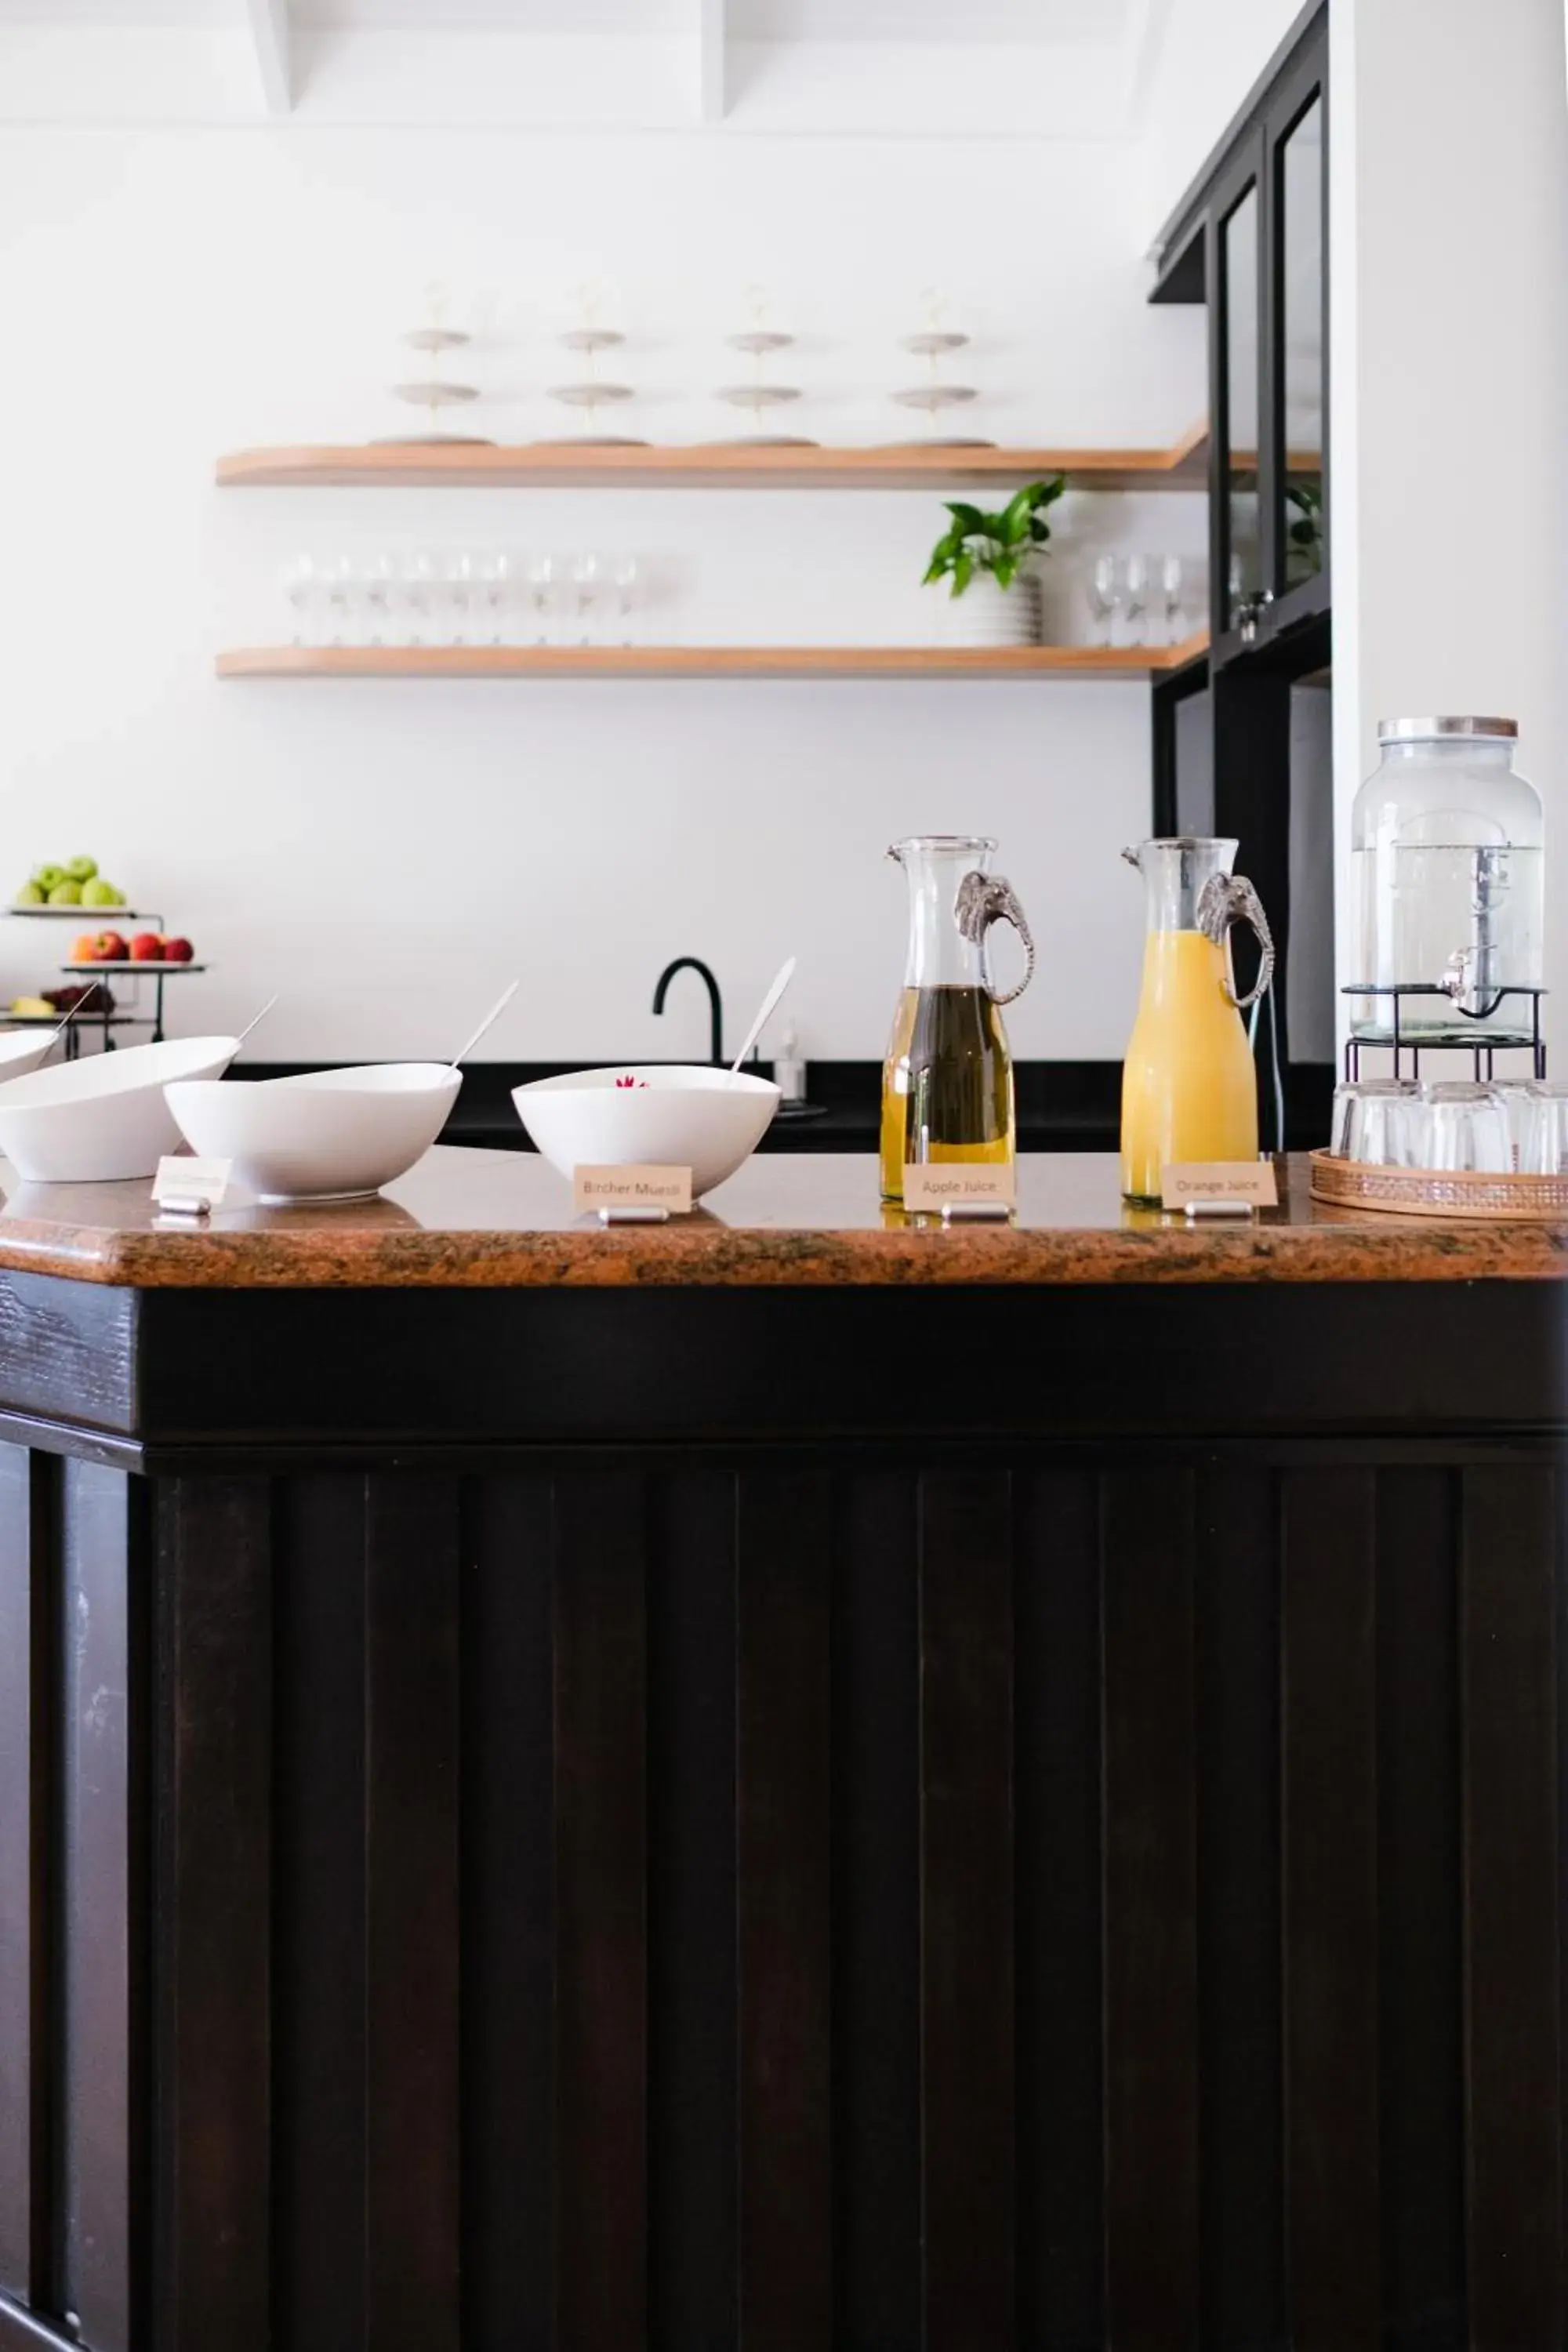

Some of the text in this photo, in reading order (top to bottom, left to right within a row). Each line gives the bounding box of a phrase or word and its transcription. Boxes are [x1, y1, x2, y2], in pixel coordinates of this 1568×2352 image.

[583, 1181, 630, 1193] Bircher
[924, 1179, 996, 1194] Apple Juice
[1176, 1179, 1258, 1194] Orange Juice
